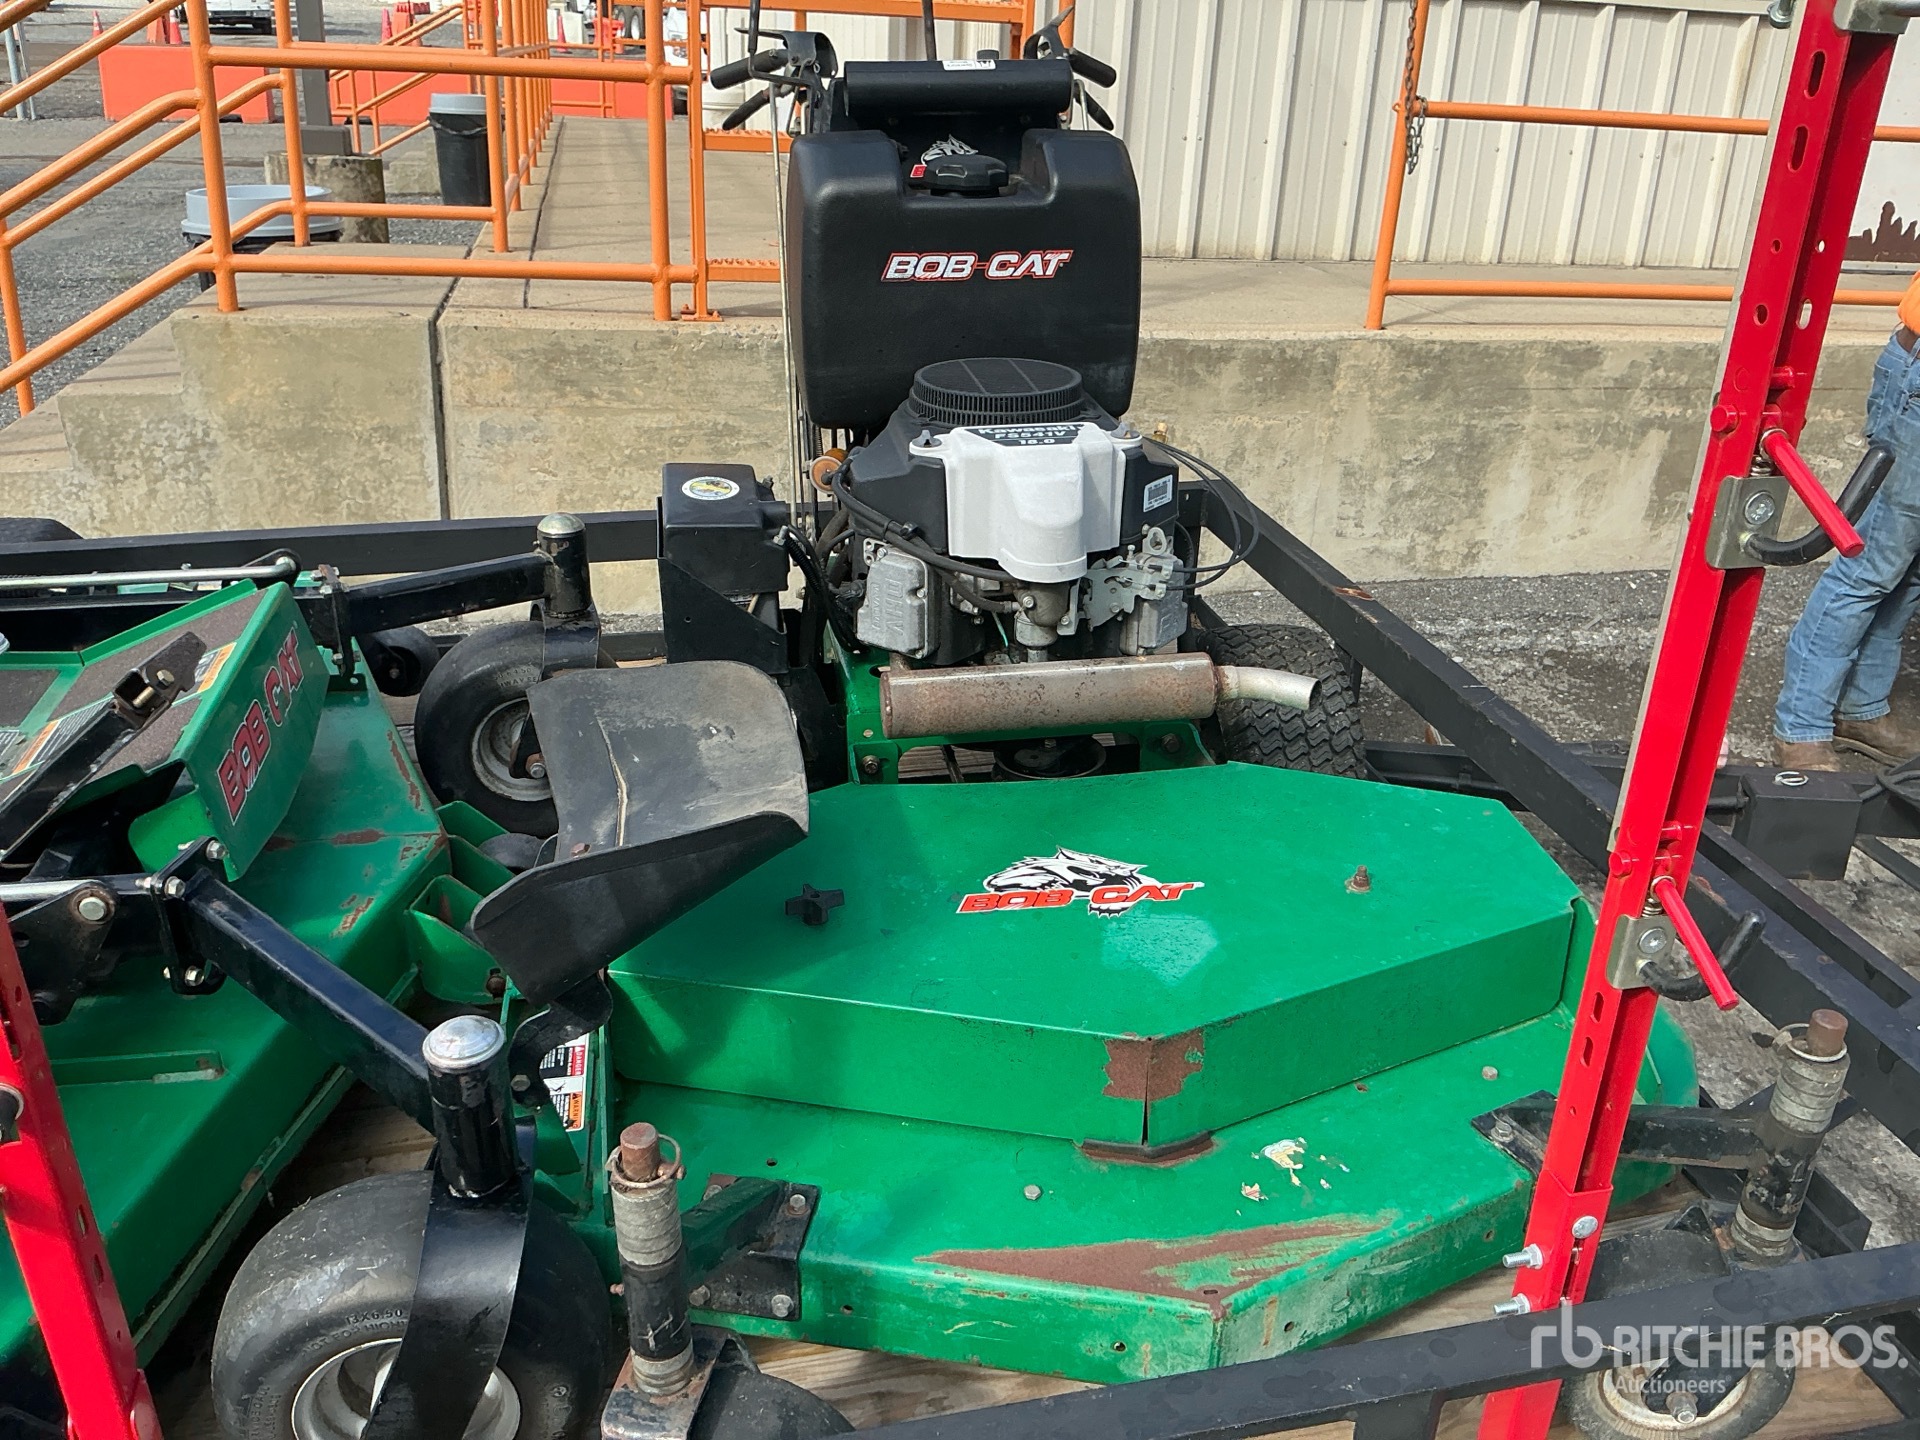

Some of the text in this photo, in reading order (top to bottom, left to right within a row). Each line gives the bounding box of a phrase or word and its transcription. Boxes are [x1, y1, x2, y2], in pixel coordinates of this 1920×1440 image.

[882, 251, 1072, 281] BOB-CAT
[978, 425, 1076, 434] Kawasaki
[958, 883, 1194, 912] BOB-CAT
